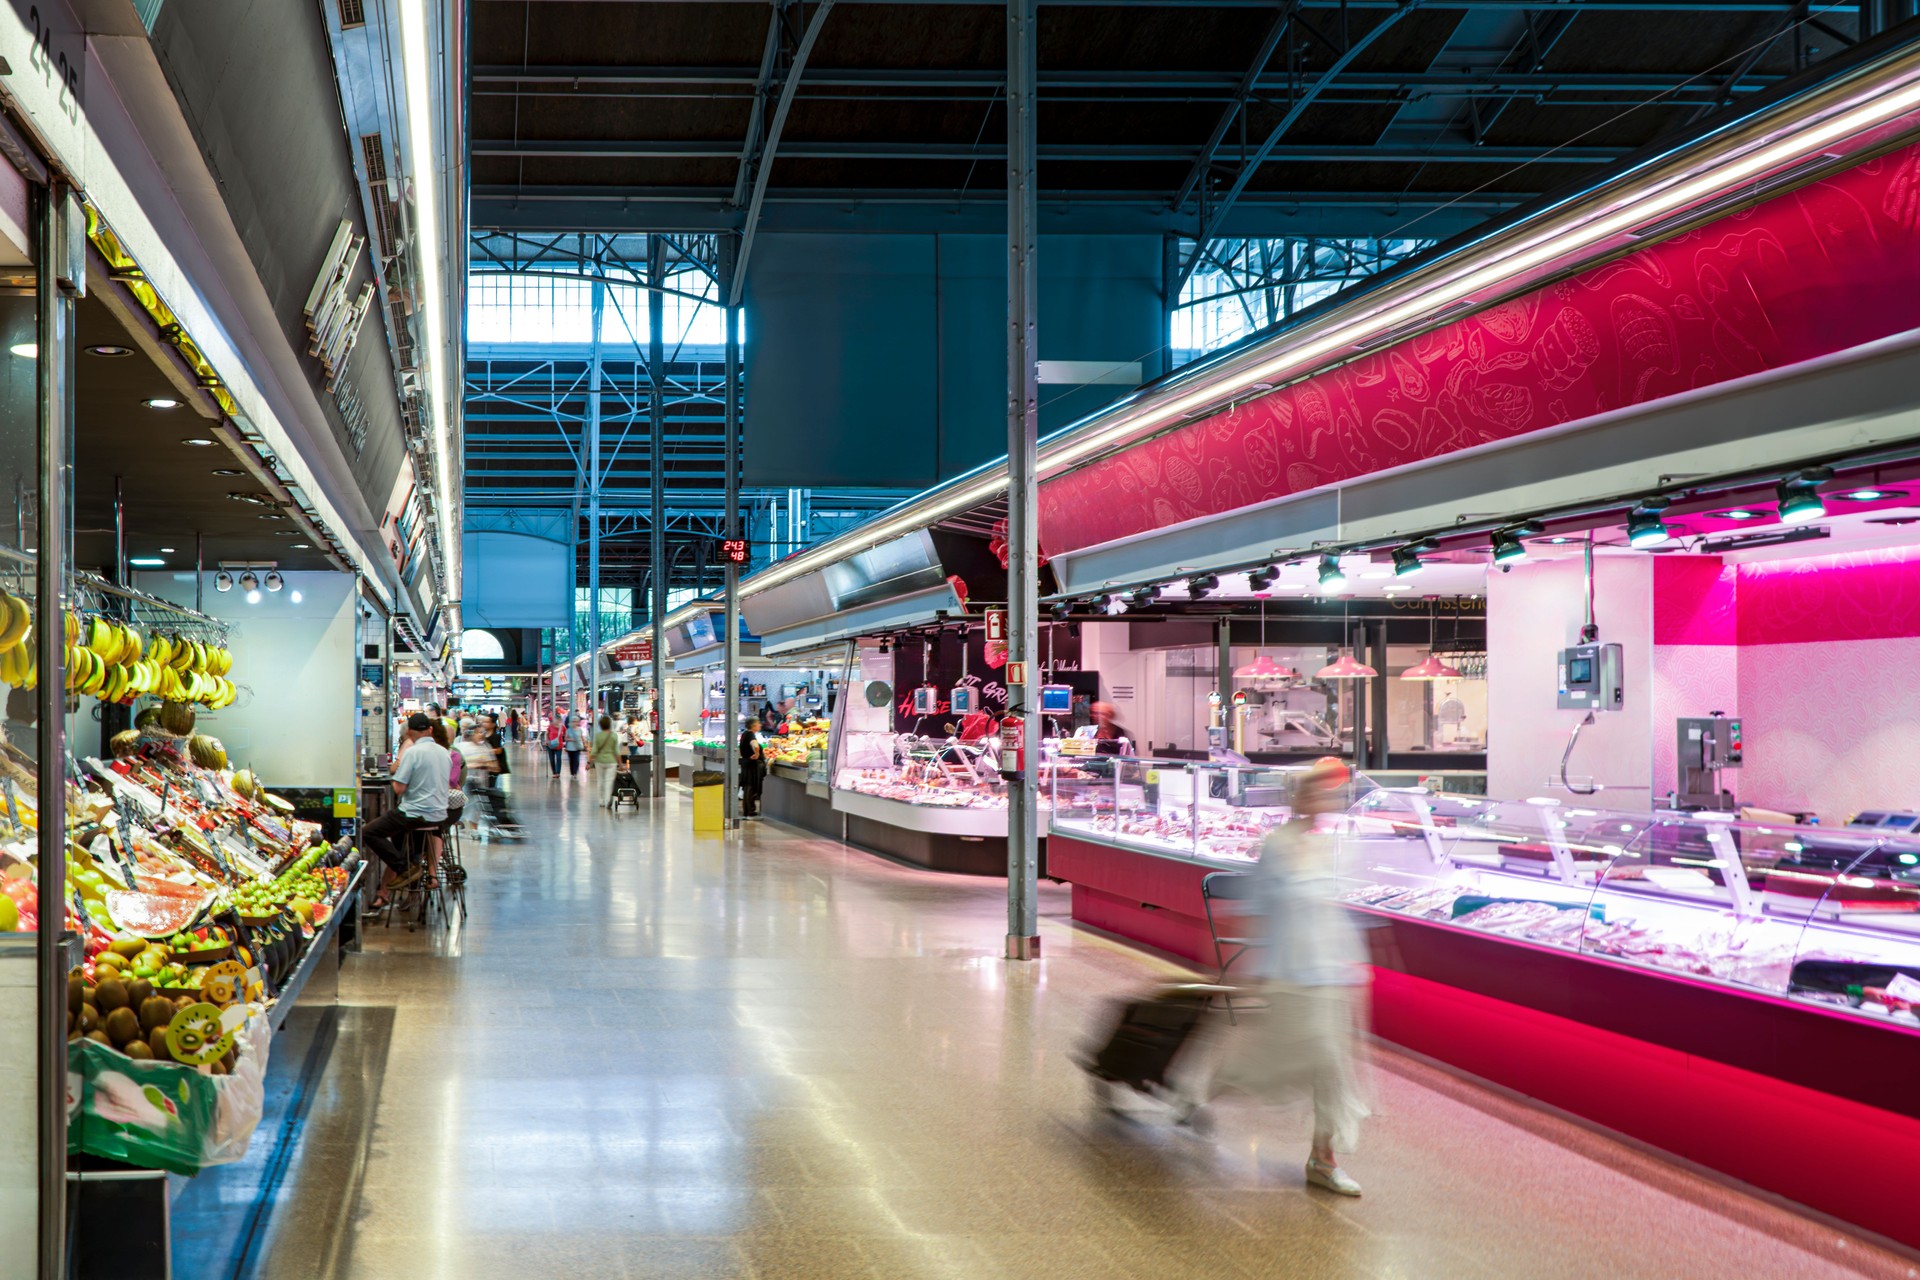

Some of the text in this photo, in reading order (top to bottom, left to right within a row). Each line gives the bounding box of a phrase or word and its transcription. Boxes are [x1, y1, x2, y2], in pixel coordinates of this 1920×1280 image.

[29, 4, 78, 126] 24 25
[730, 551, 745, 561] 48
